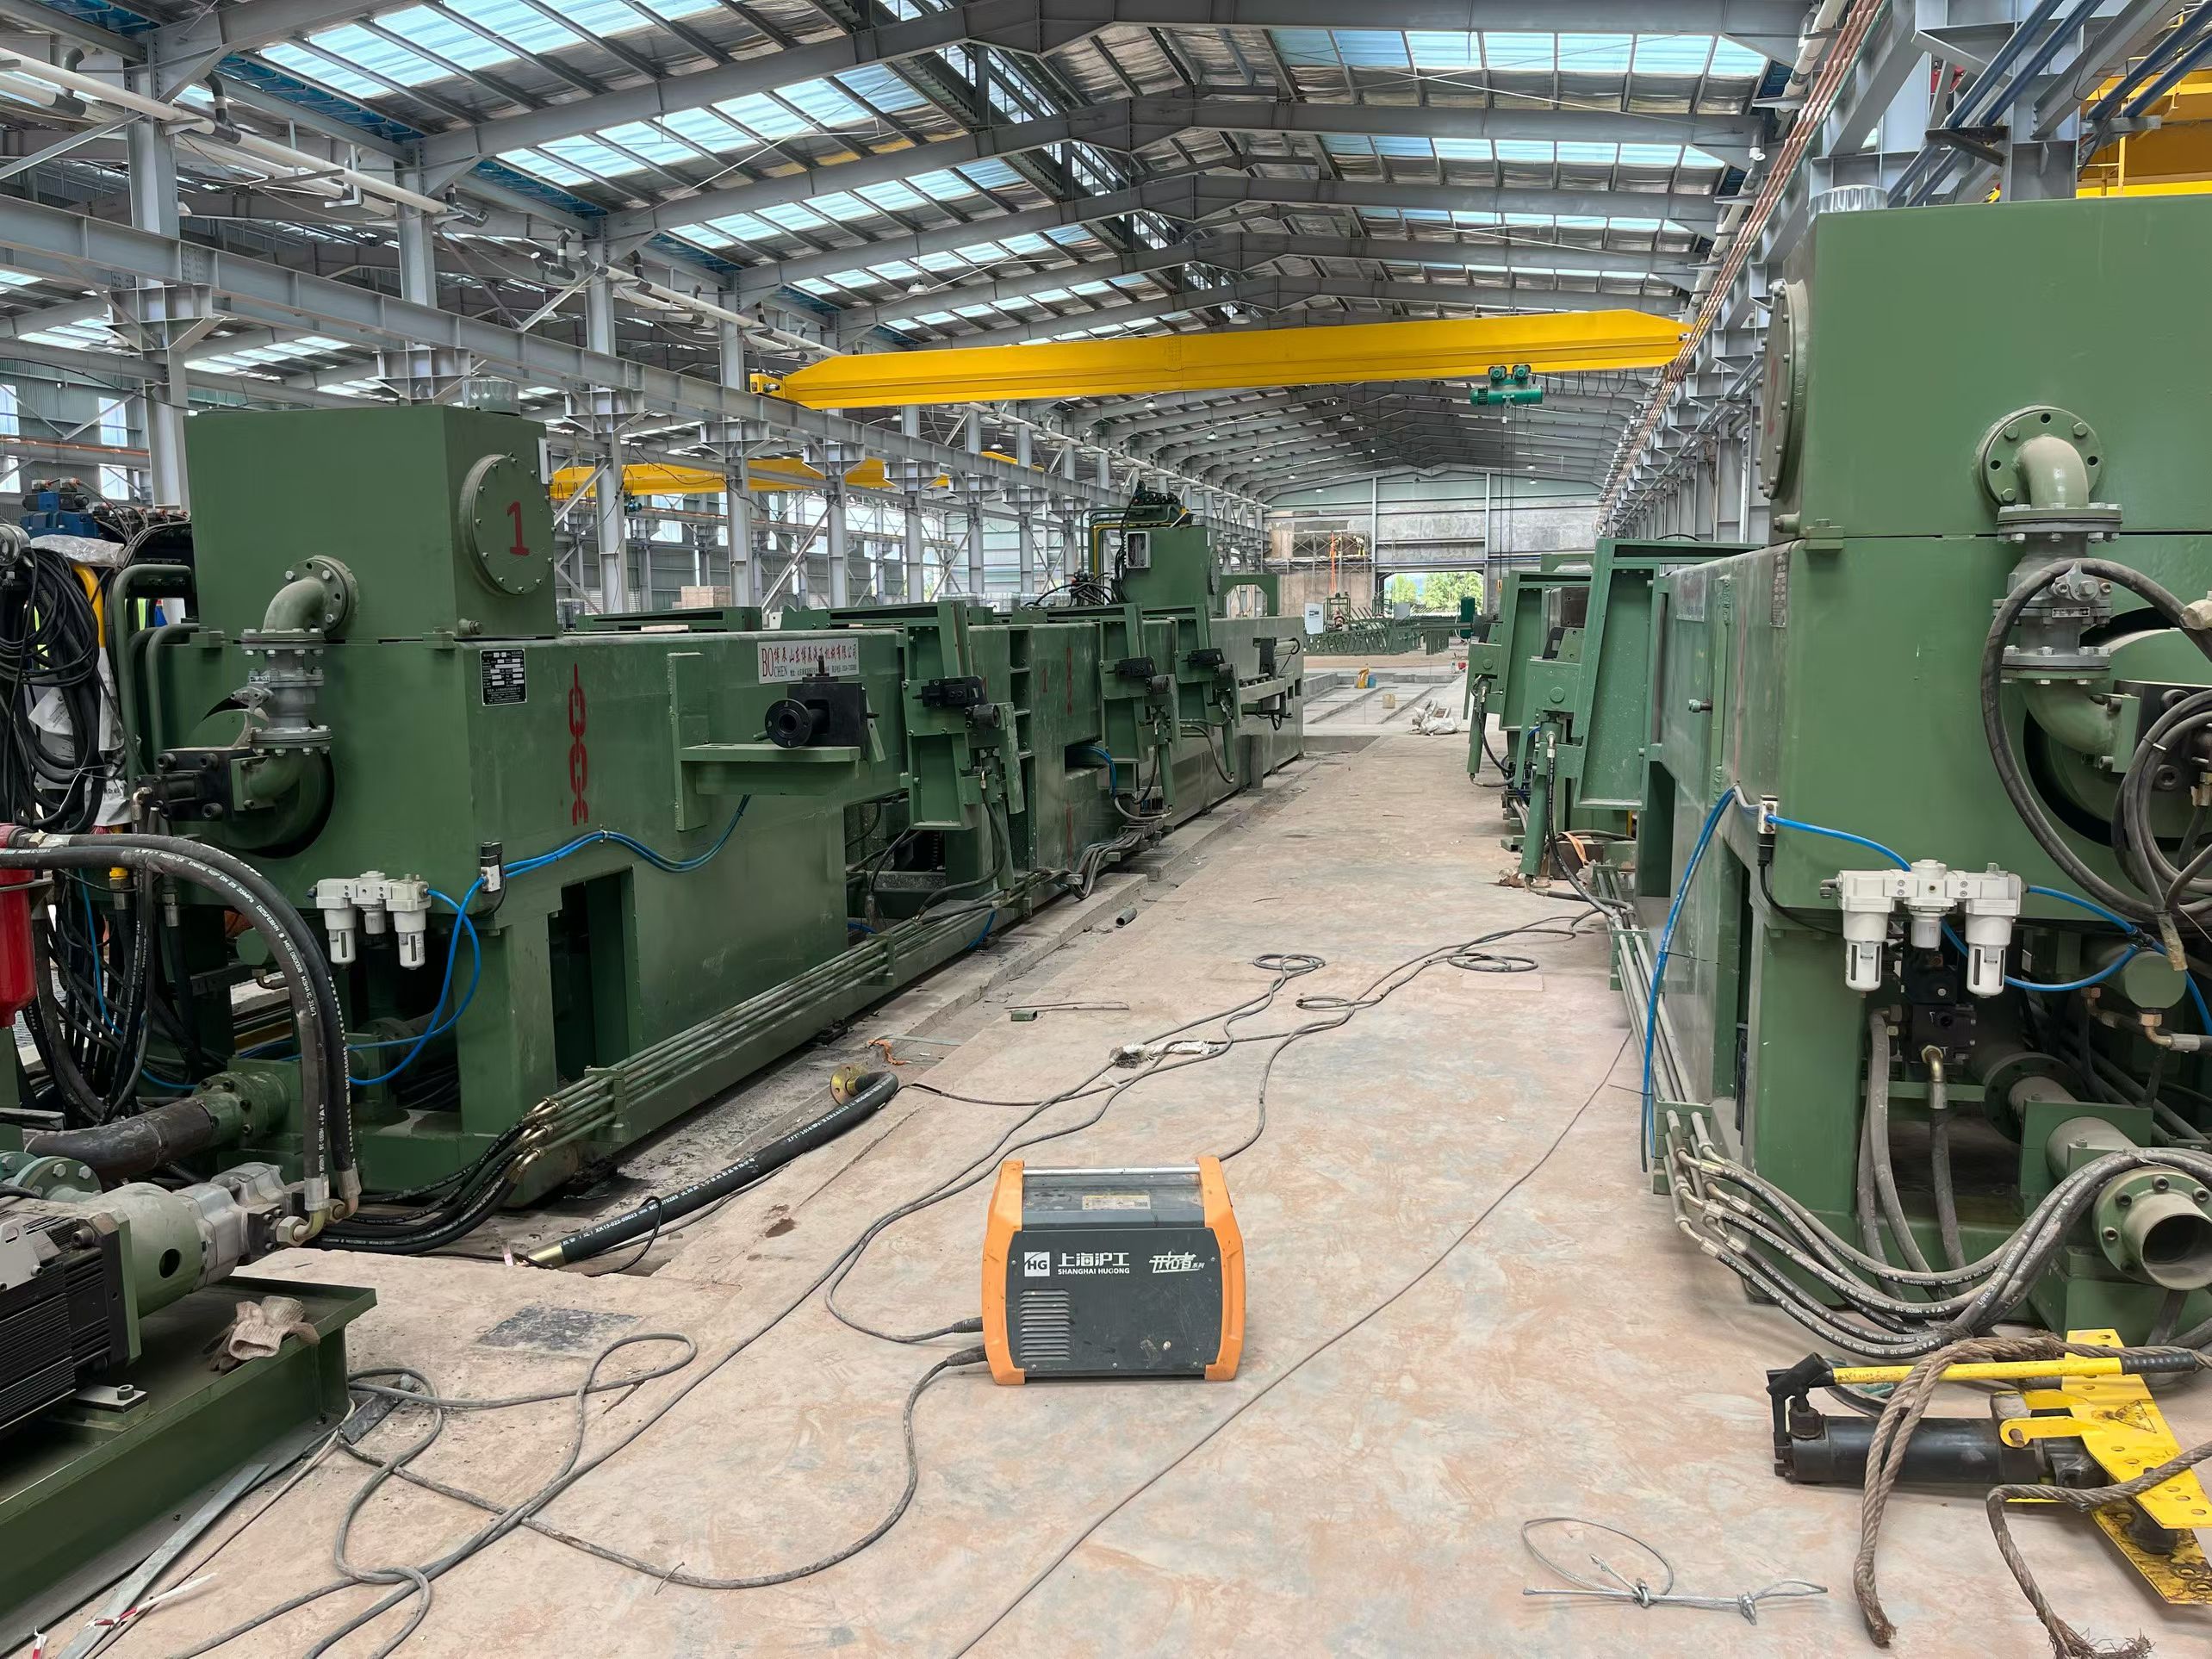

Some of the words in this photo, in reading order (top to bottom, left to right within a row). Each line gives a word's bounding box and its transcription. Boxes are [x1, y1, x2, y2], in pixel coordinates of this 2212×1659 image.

[507, 501, 529, 556] 1
[761, 648, 774, 677] BO
[774, 665, 787, 677] CHEN
[1028, 1260, 1047, 1271] HG
[1058, 1252, 1130, 1267] 上海沪工
